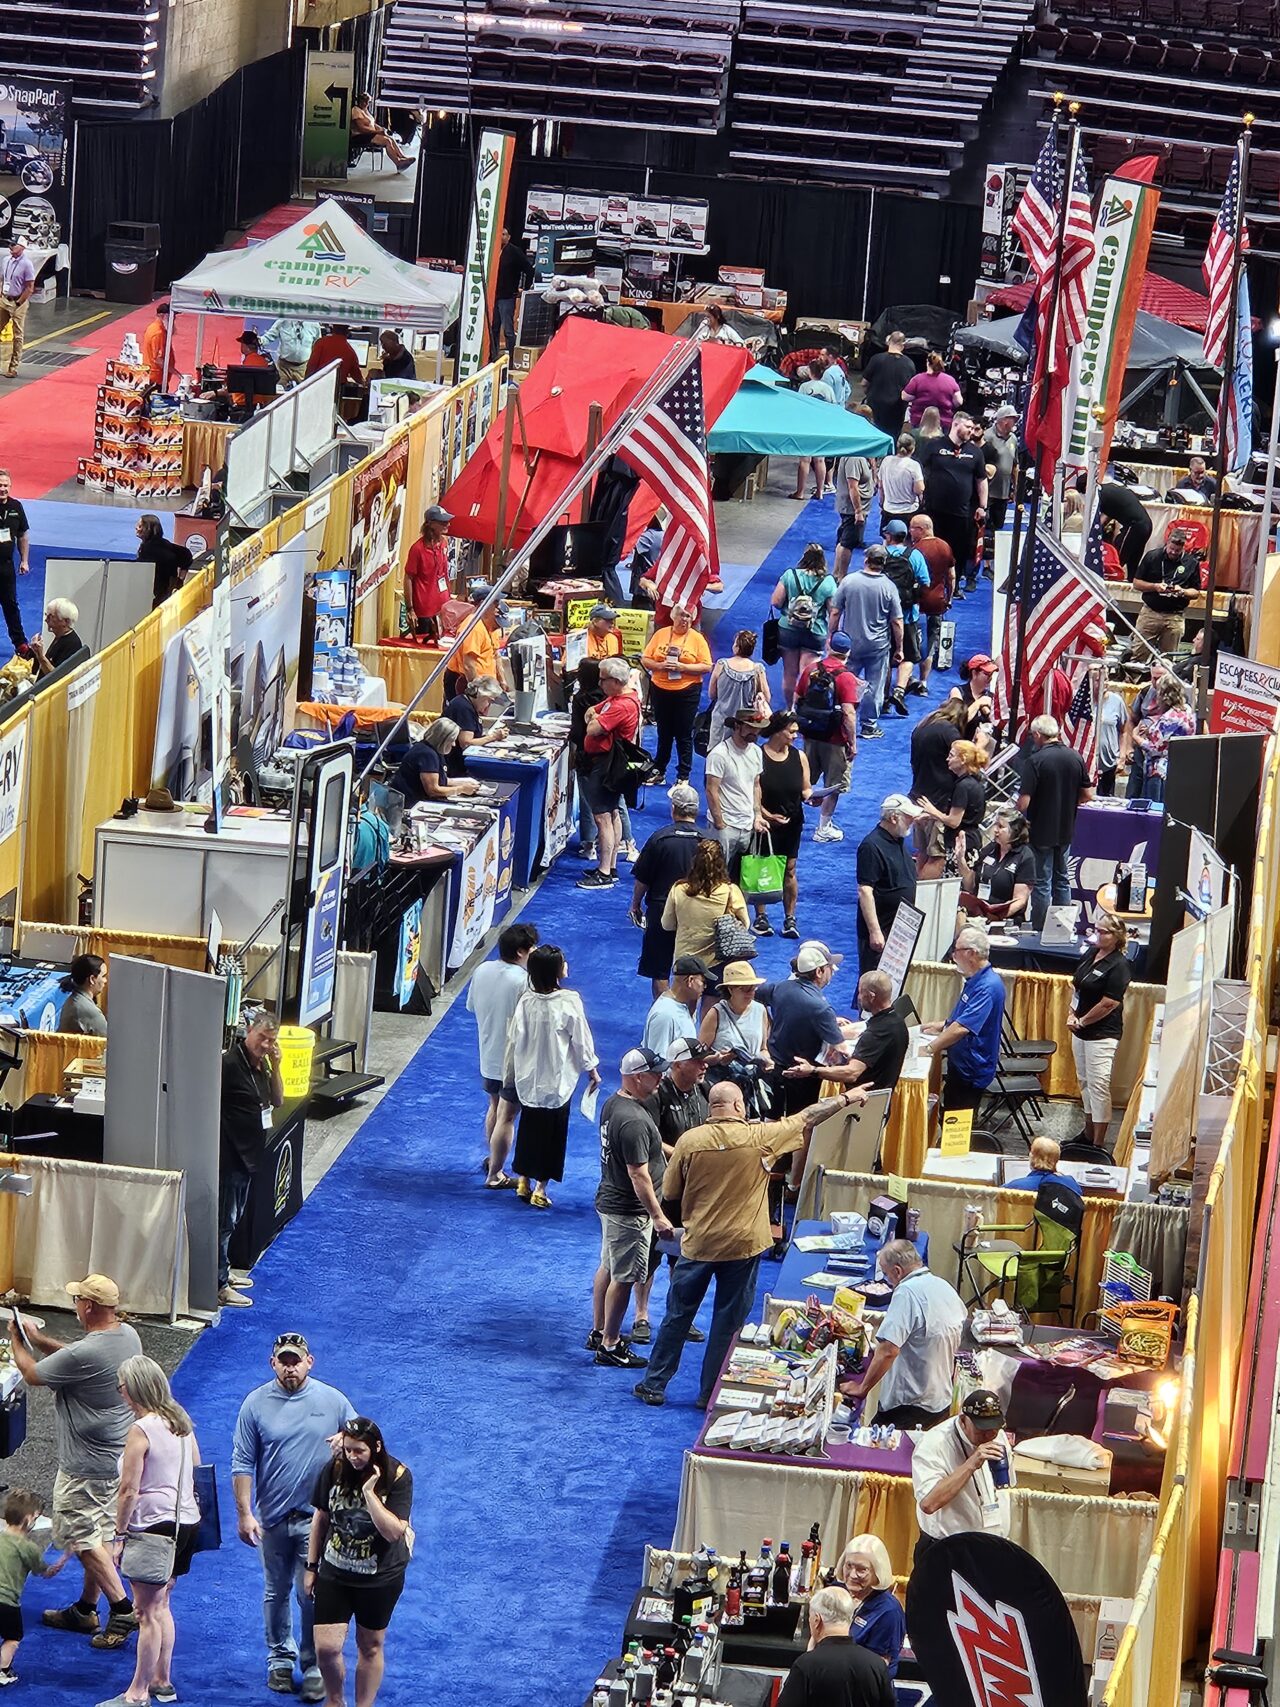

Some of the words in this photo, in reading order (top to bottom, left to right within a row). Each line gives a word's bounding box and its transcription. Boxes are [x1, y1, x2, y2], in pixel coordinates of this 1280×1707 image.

[8, 85, 56, 106] SnapPad
[264, 258, 371, 276] campers
[466, 187, 492, 341] campers
[278, 272, 321, 286] inn
[325, 275, 363, 288] RV
[628, 288, 653, 299] KING
[383, 303, 417, 321] RV
[1078, 235, 1120, 387] campers
[1219, 662, 1258, 685] ESCAPEES
